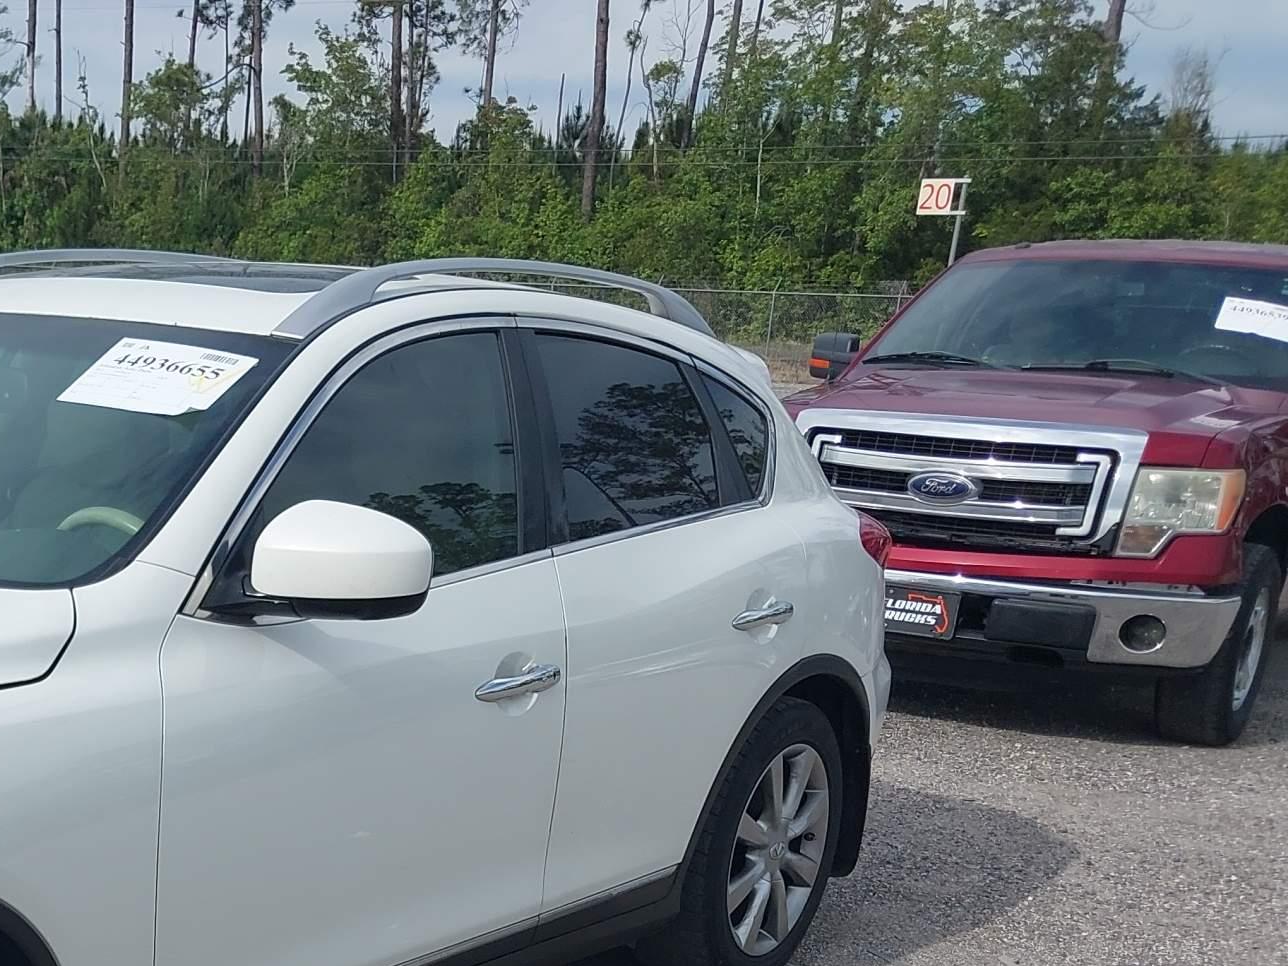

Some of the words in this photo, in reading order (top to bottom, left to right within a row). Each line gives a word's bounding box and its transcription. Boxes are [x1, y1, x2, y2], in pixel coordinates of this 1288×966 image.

[919, 183, 951, 210] 20
[113, 353, 225, 380] 44936655
[921, 478, 957, 494] Ford
[885, 599, 942, 614] LORIDA
[884, 609, 938, 625] RUCKS
